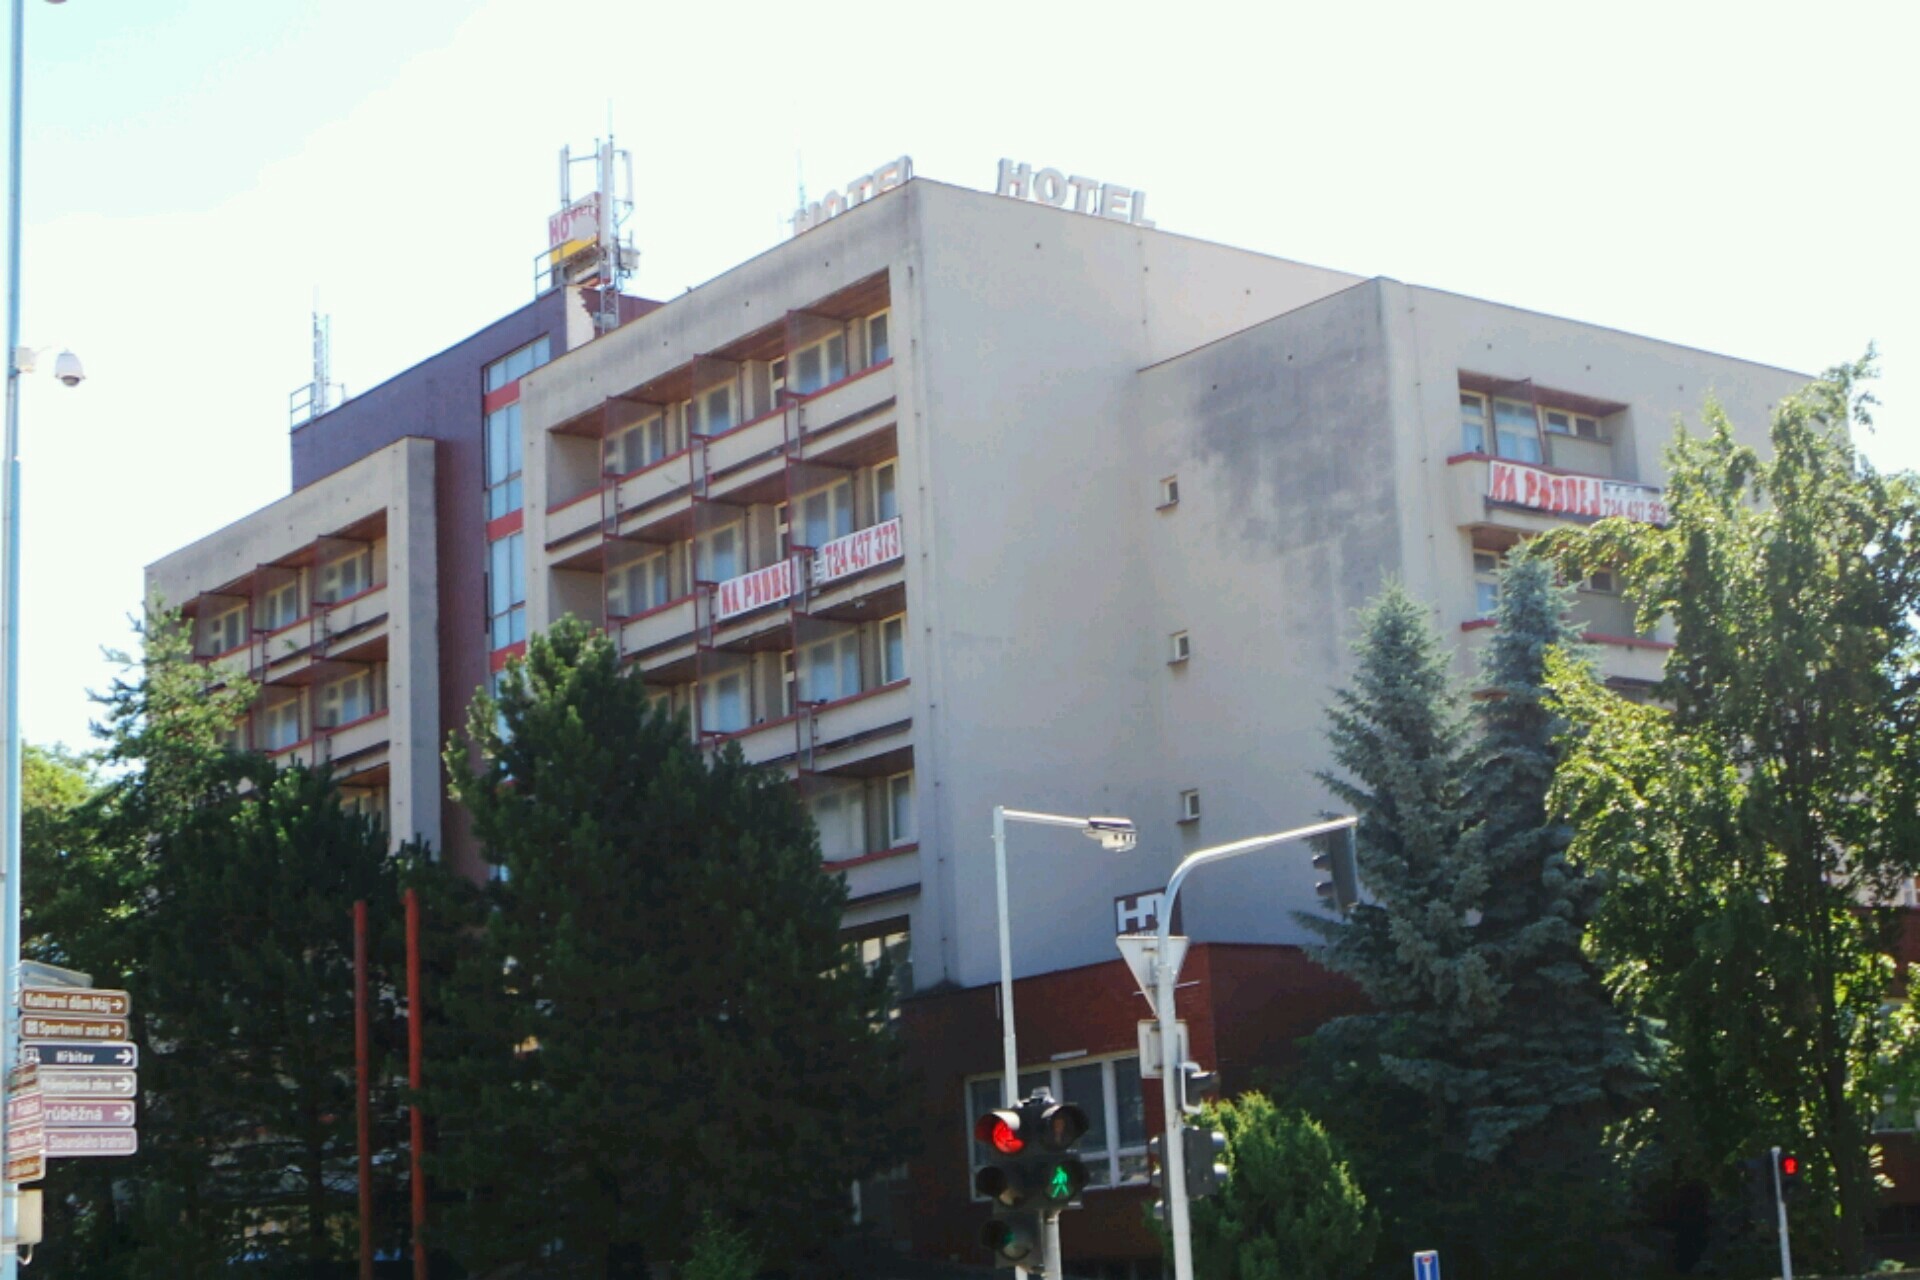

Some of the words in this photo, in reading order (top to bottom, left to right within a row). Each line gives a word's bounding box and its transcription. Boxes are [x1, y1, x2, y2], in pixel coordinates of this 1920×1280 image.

[997, 157, 1155, 228] HOTEL
[1493, 464, 1517, 502] NA
[1525, 470, 1600, 517] PRODEJ
[825, 541, 848, 578] 724
[851, 529, 872, 571] 437
[875, 522, 898, 562] 373
[721, 579, 740, 616] NA
[25, 993, 68, 1008] Kulturní
[69, 995, 91, 1010] dům
[39, 1021, 84, 1036] Sportovní
[56, 1050, 95, 1063] Hřbitov
[45, 1105, 103, 1120] růběžná
